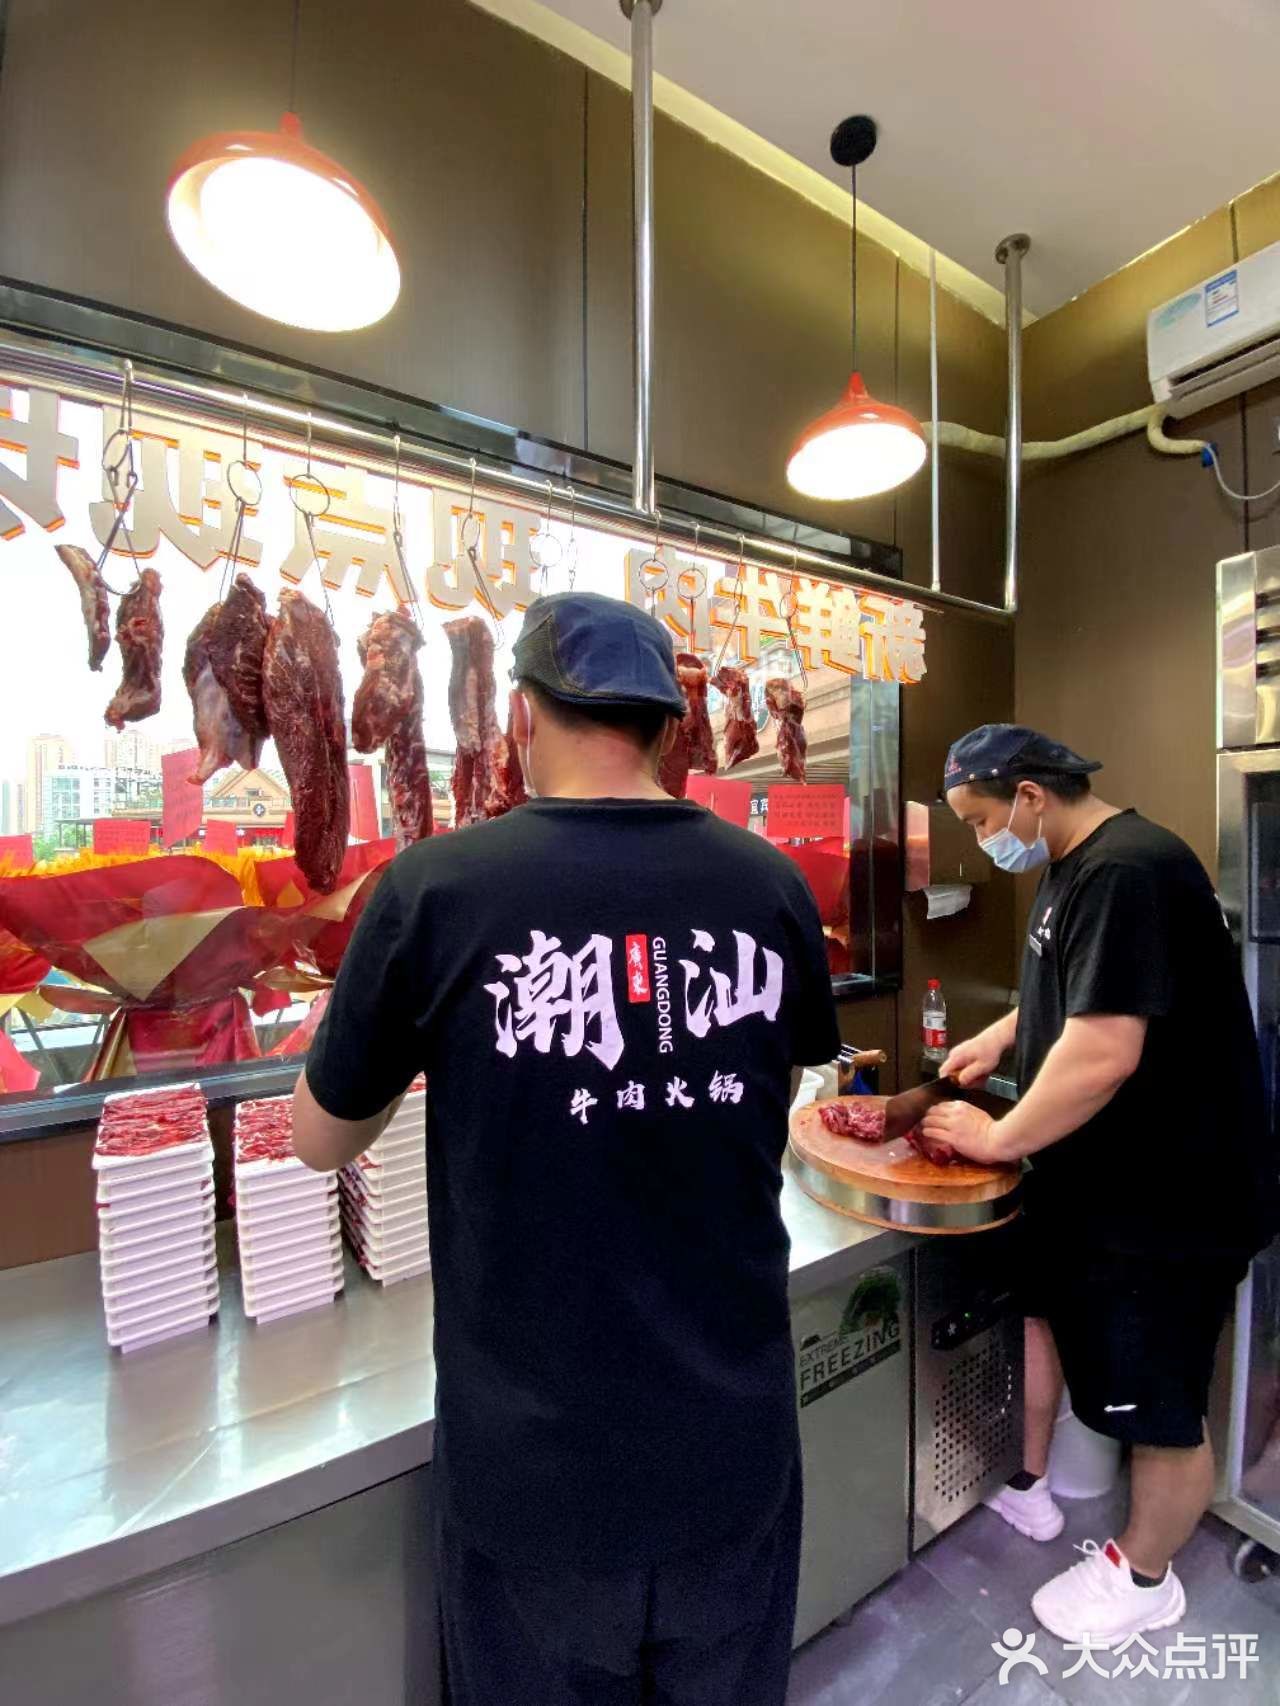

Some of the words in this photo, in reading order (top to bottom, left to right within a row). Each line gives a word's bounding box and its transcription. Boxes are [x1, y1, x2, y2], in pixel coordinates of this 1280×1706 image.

[652, 936, 674, 1054] GUANGDONG
[569, 1070, 744, 1125] 牛肉火锅
[799, 1320, 900, 1391] FREEZING
